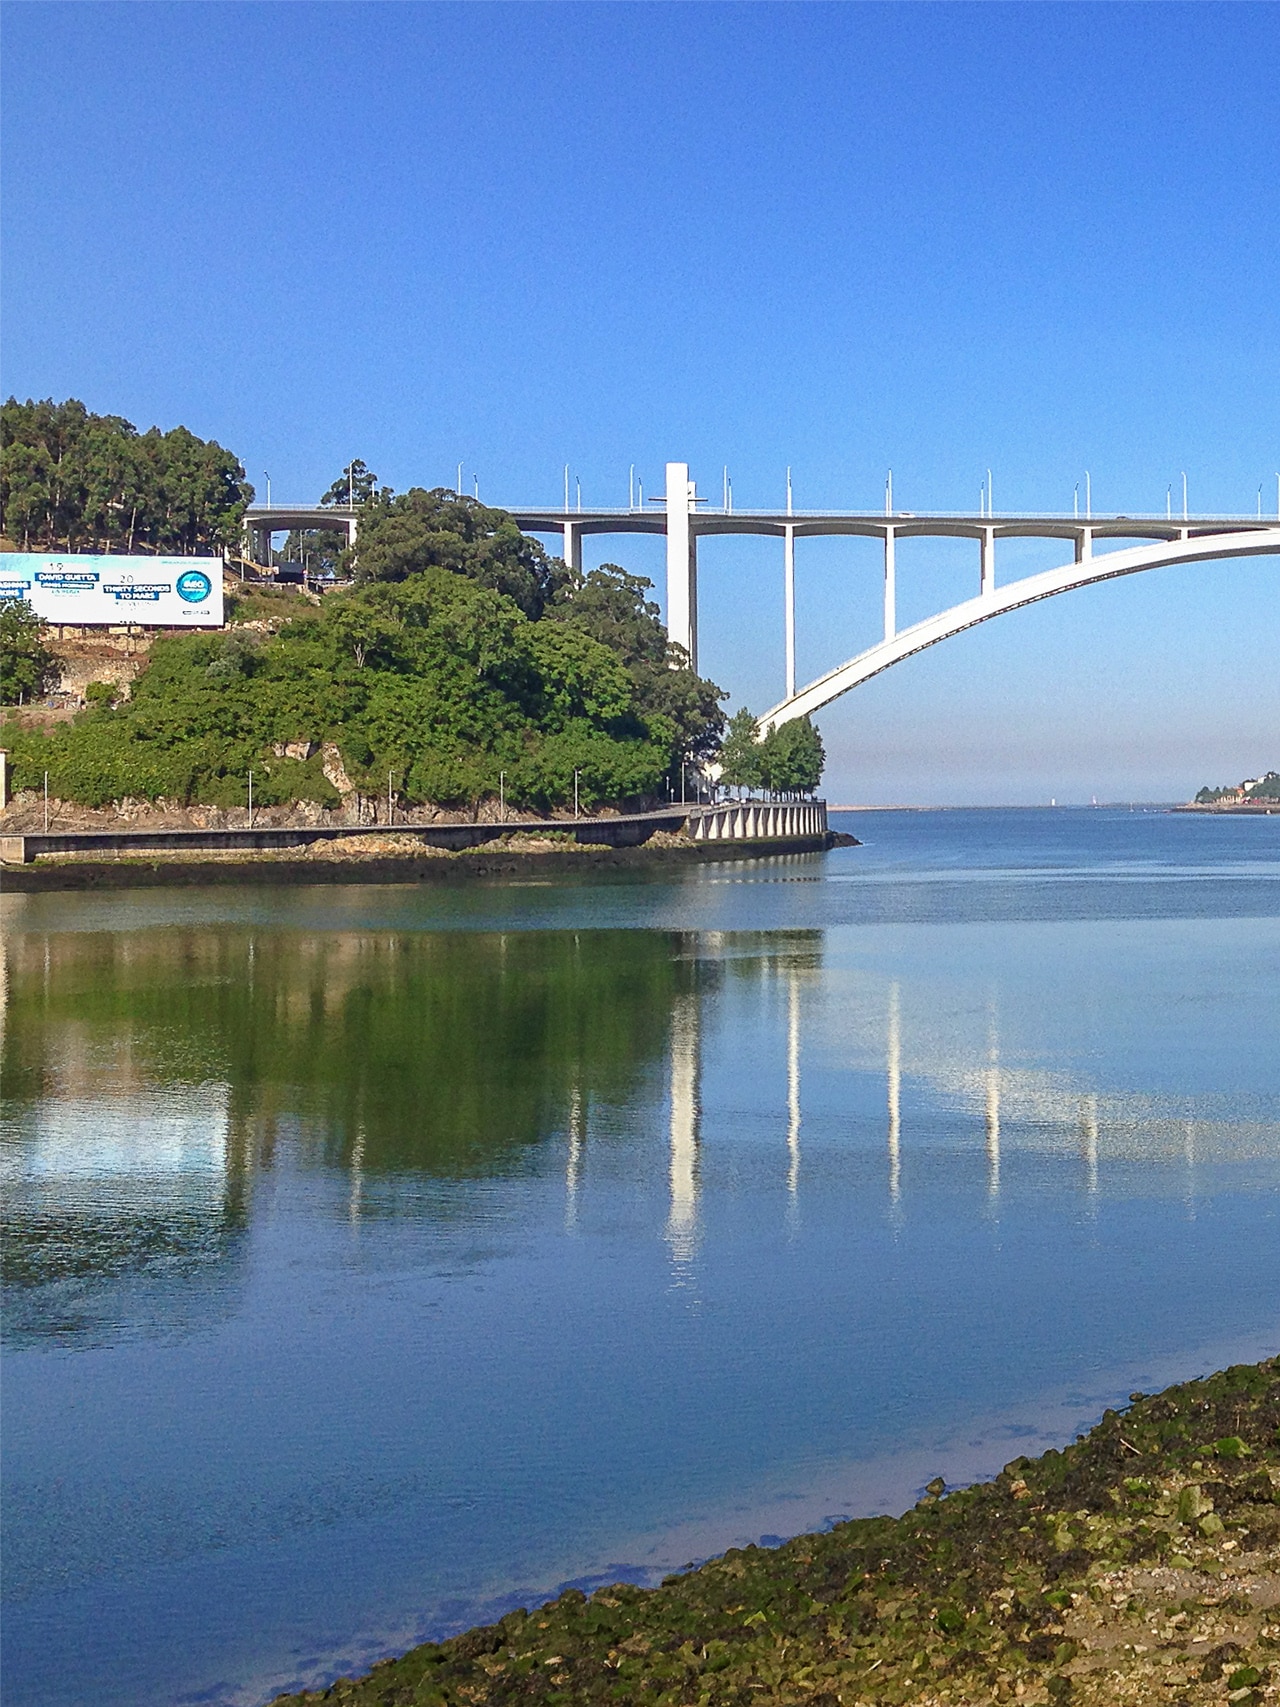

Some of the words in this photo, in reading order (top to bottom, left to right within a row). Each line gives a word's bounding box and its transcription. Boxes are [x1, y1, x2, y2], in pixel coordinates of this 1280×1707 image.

[38, 573, 64, 581] DAVID
[64, 573, 97, 581] GUETTA
[120, 575, 134, 584] 20
[133, 585, 170, 593] SECONDS
